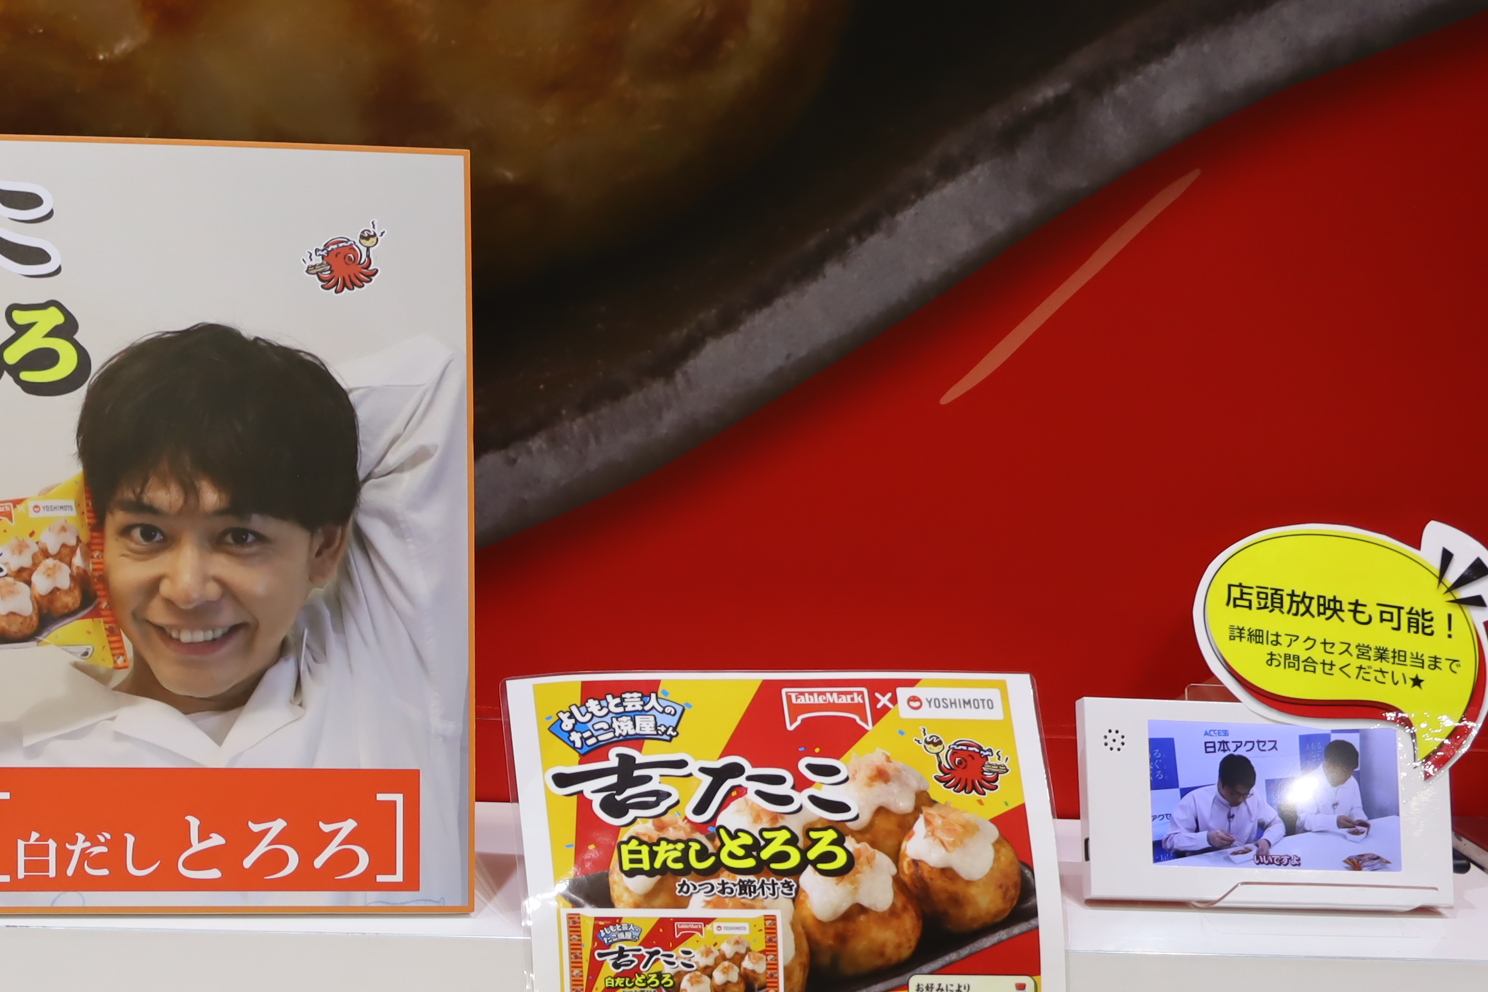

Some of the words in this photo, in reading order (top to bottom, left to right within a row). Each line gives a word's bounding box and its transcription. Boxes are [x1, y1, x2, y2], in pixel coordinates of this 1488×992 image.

[42, 504, 74, 512] YOSHIMOTO
[1225, 582, 1457, 639] 店頭放映も可能！
[1228, 624, 1461, 674] 詳細はアクセス営業担当まで
[556, 691, 676, 734] よしもと芸人の
[787, 691, 864, 705] TableMark
[925, 695, 995, 711] YOSHIMOTO
[569, 715, 679, 750] たこ焼屋さん
[1204, 739, 1278, 754] 日本アクセス
[548, 751, 858, 820] 吉たこ
[620, 828, 850, 873] 白だしとろろ
[1253, 854, 1301, 866] いいですよ
[675, 877, 797, 899] かつお節付き
[596, 945, 697, 971] 吉たこ
[605, 973, 675, 988] 白だしとろろ
[916, 983, 970, 992] お好みにより
